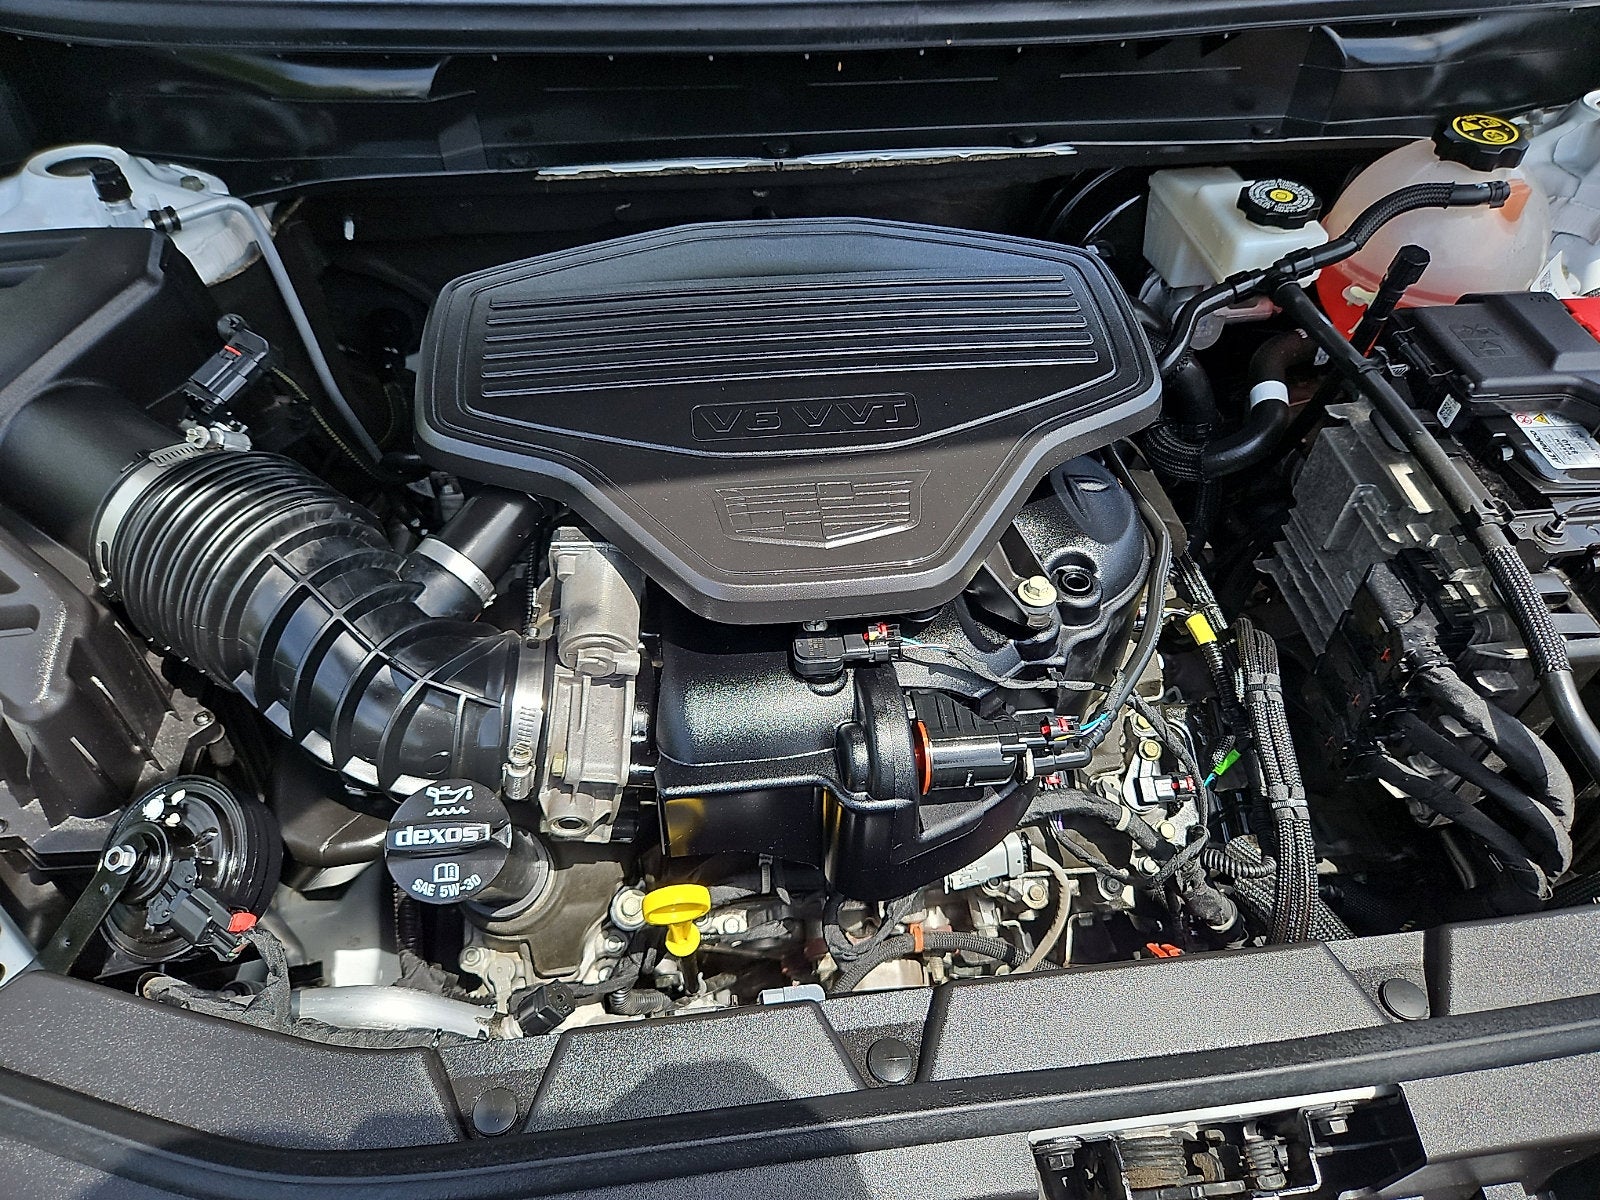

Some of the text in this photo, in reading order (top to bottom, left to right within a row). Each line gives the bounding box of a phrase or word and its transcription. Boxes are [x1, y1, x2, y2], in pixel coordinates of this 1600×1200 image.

[701, 398, 907, 433] V6 VVT
[411, 873, 482, 898] SAE 5W-30
